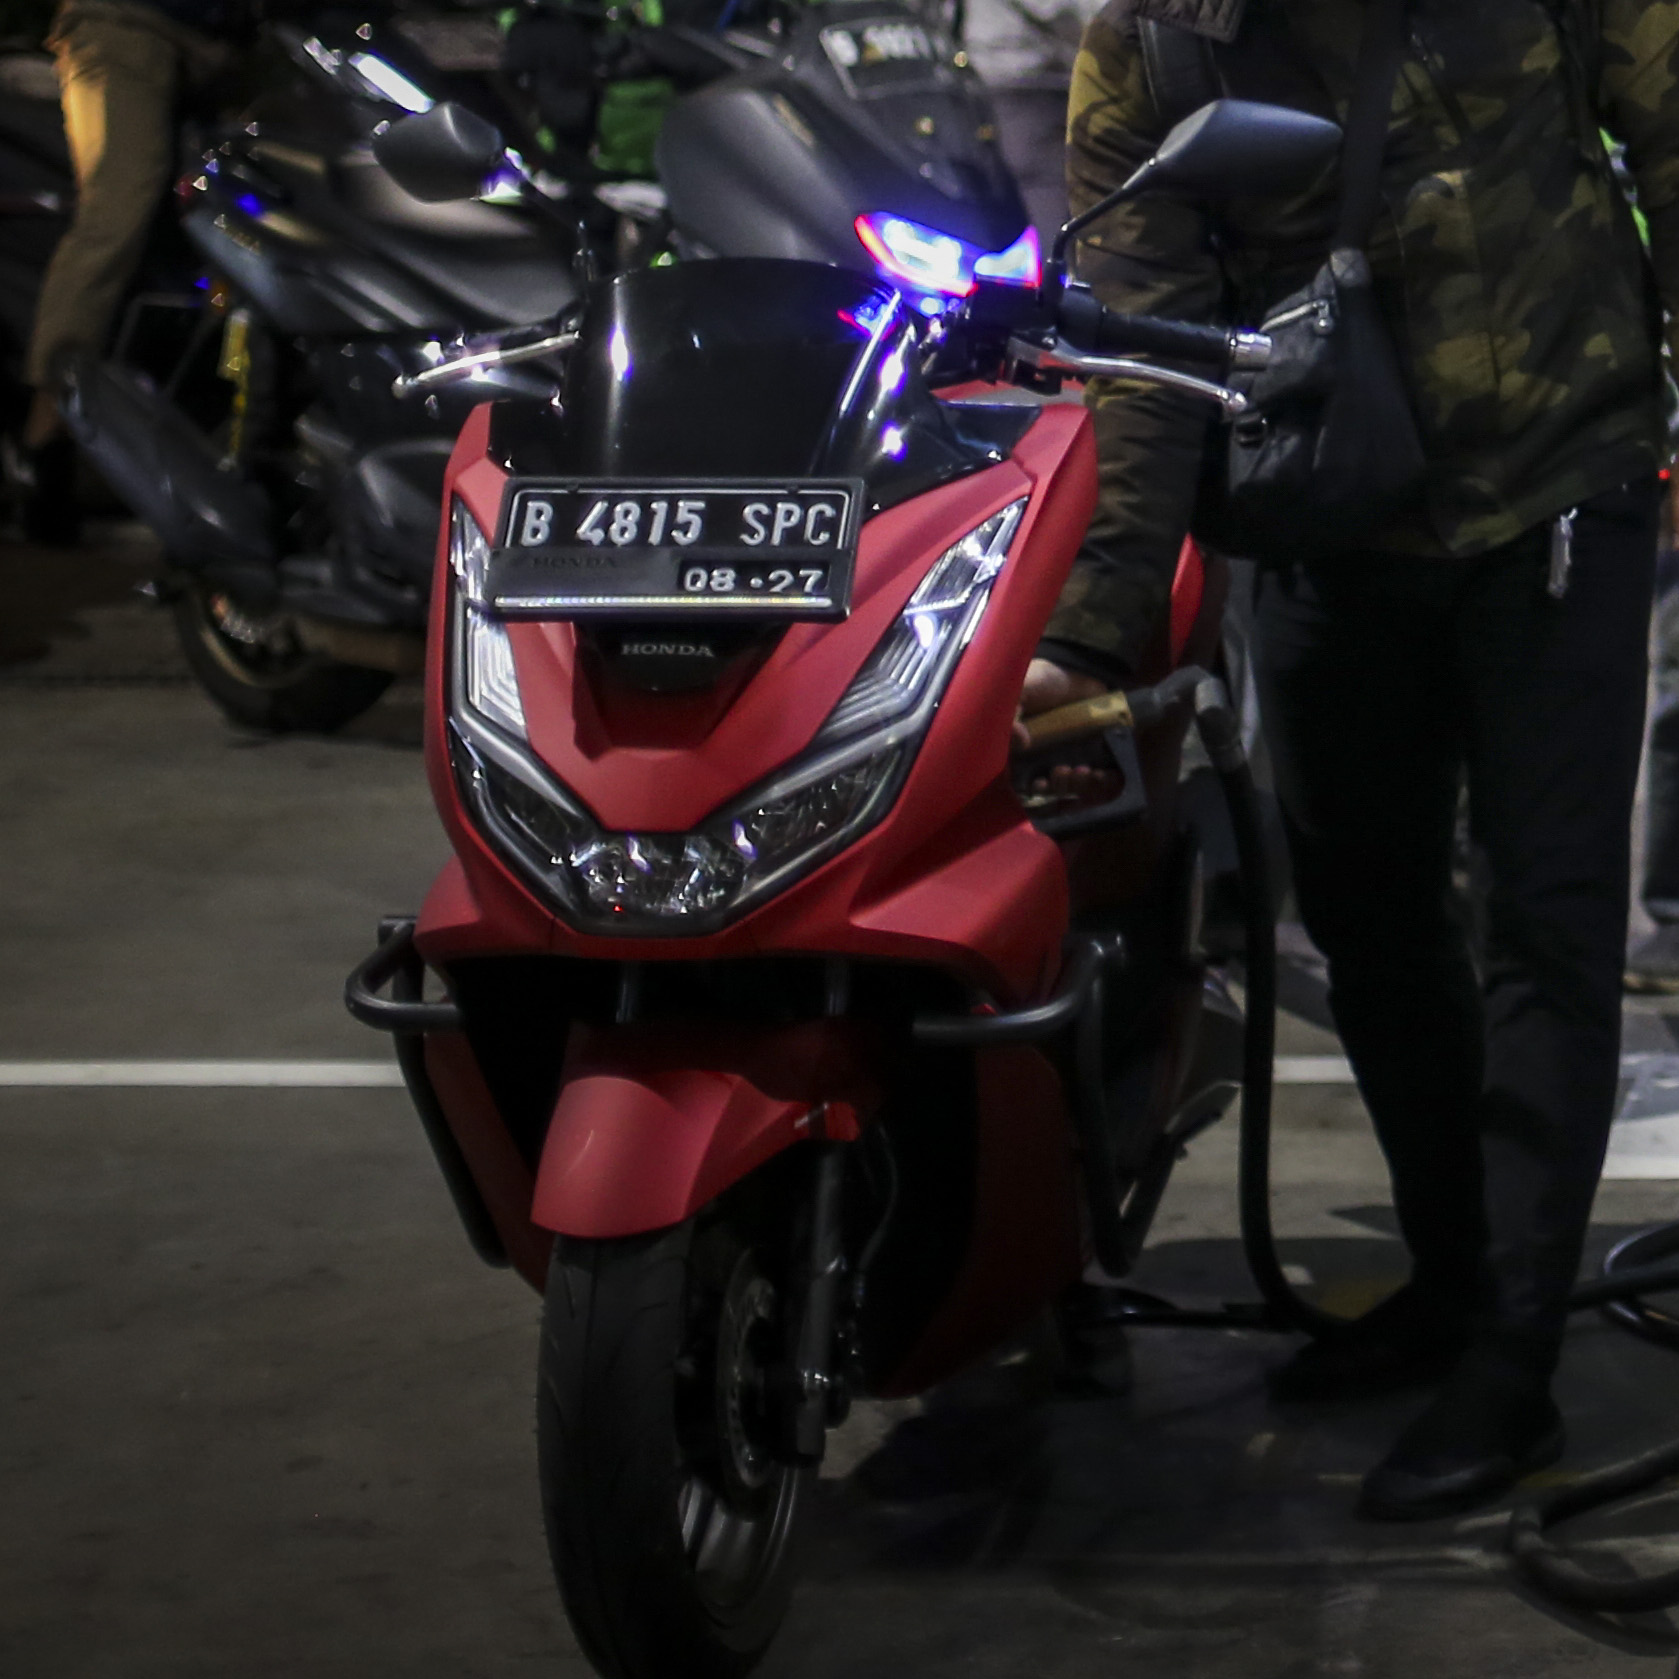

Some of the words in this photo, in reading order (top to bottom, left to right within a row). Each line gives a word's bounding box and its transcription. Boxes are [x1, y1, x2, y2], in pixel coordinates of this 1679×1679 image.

[520, 500, 554, 547] B
[576, 500, 706, 547] 4815
[740, 501, 836, 547] SPC
[621, 642, 715, 658] HONDA
